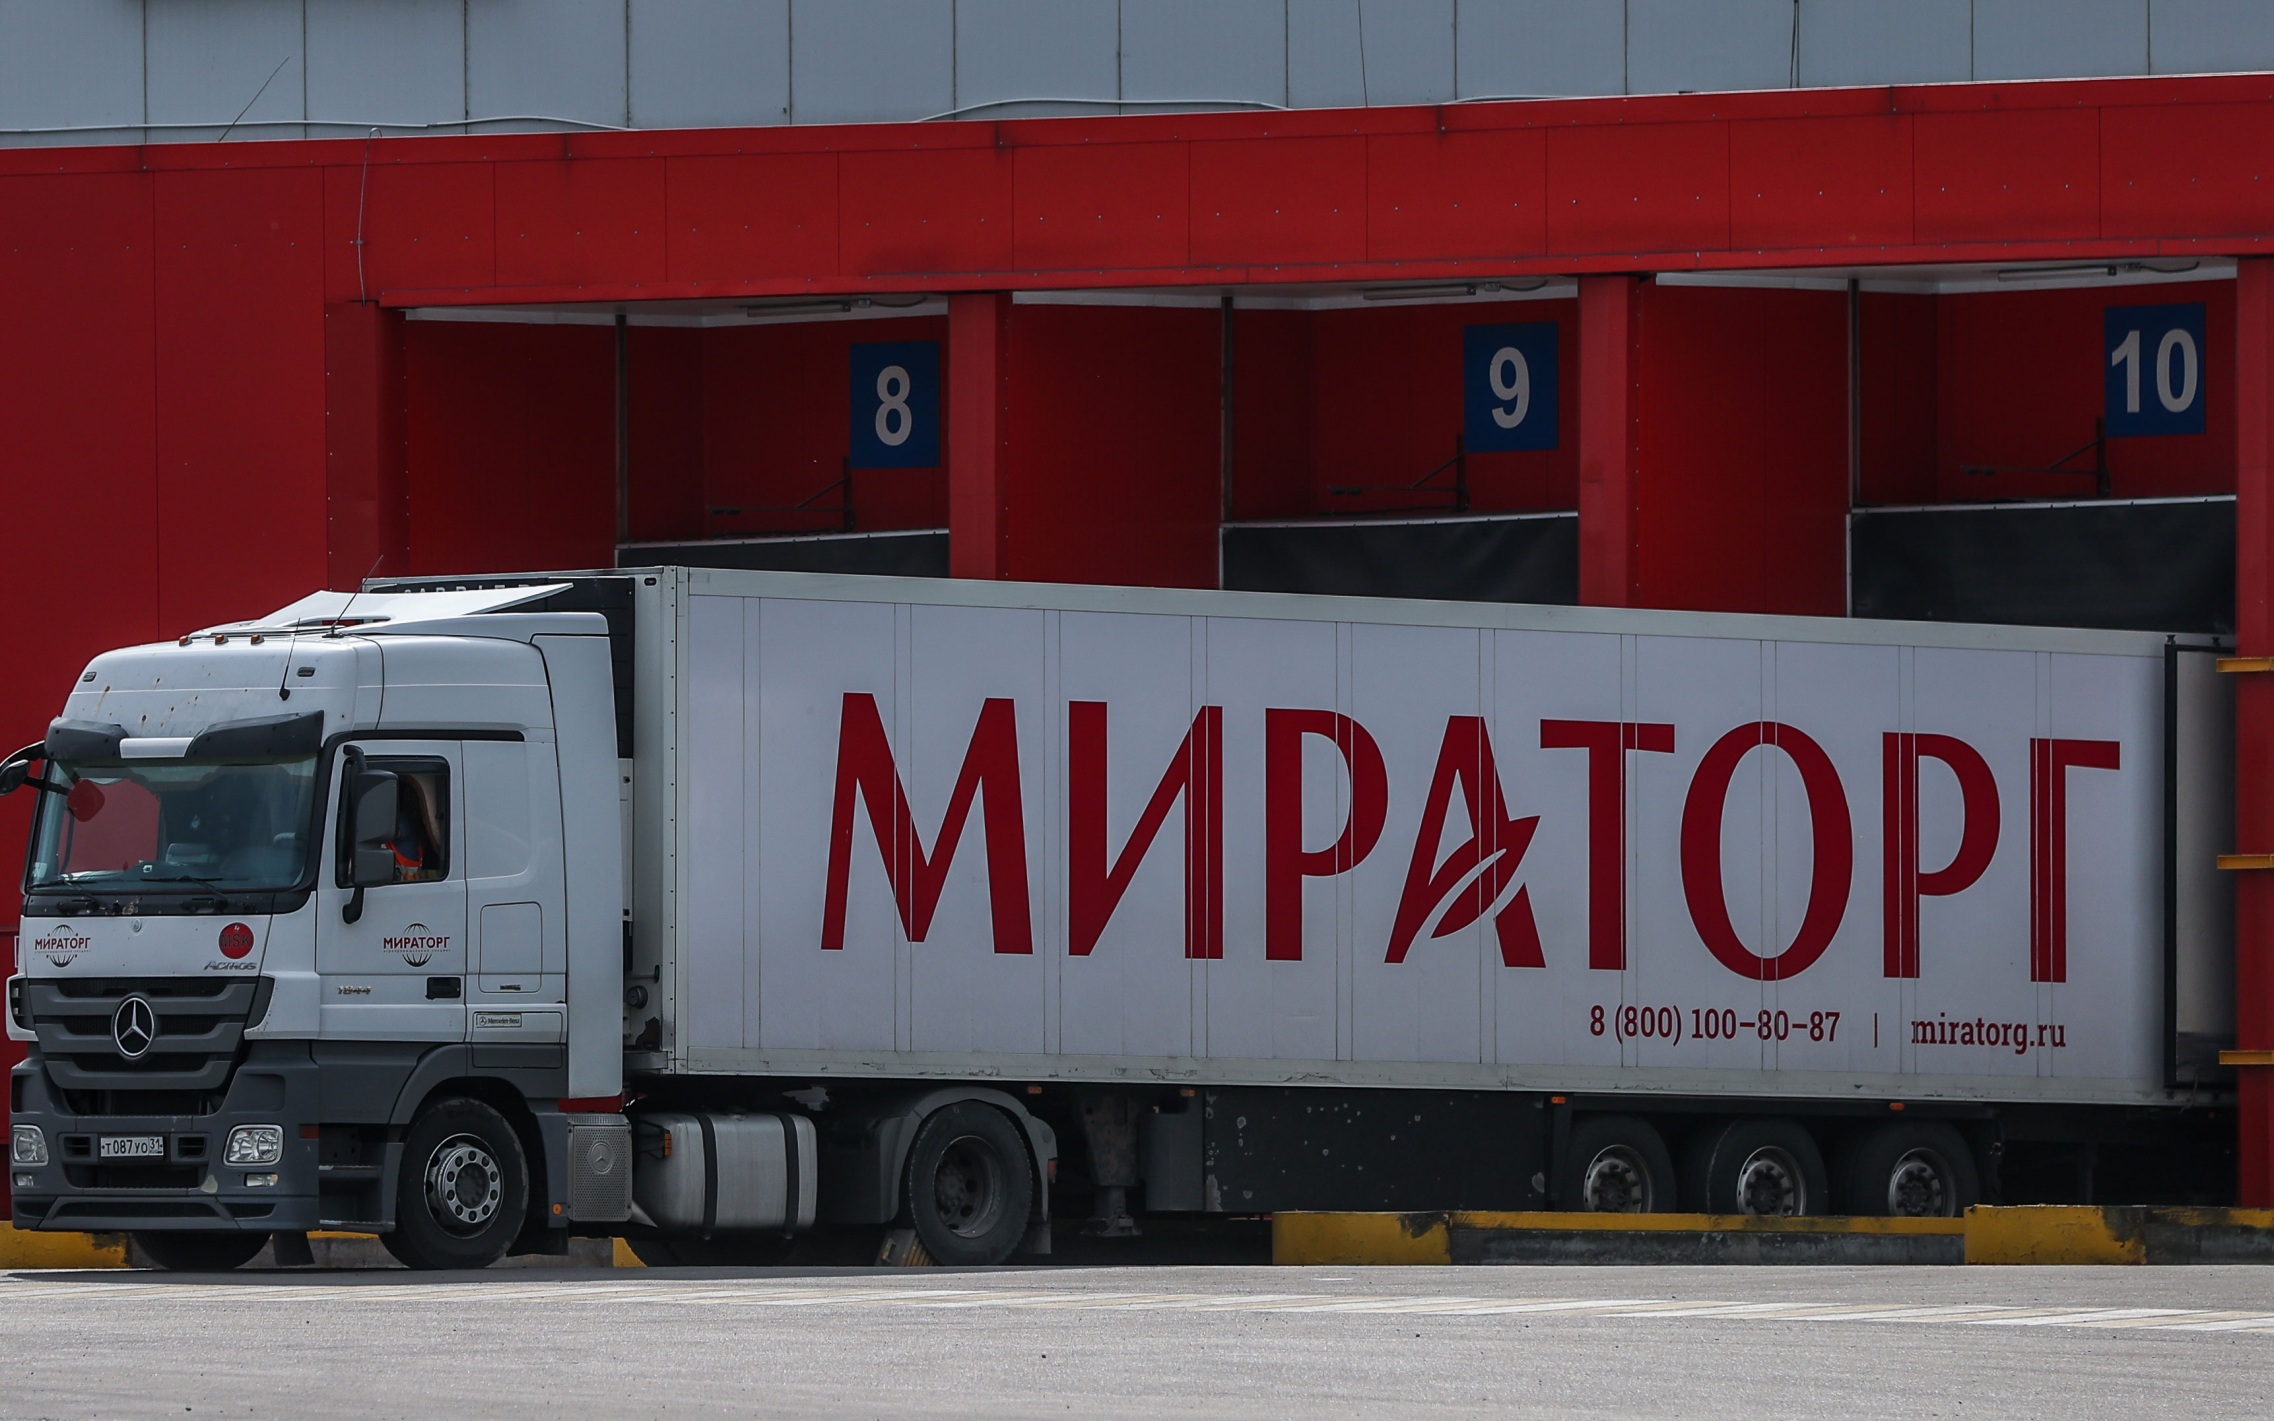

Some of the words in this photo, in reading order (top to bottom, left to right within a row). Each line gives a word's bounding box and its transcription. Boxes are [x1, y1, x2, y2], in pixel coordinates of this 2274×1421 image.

[1489, 346, 1531, 430] 9
[2110, 328, 2198, 414] 10
[873, 366, 912, 446] 8
[822, 692, 2120, 983] МИРАТОРГ
[34, 937, 91, 950] МИРАТОРГ
[383, 936, 450, 949] МИРАТОРГ
[1589, 1004, 1605, 1036] 8
[1614, 1004, 1682, 1047] (800)
[1691, 1007, 1841, 1042] 100-80-87
[1911, 1012, 2066, 1055] miratorg.ru
